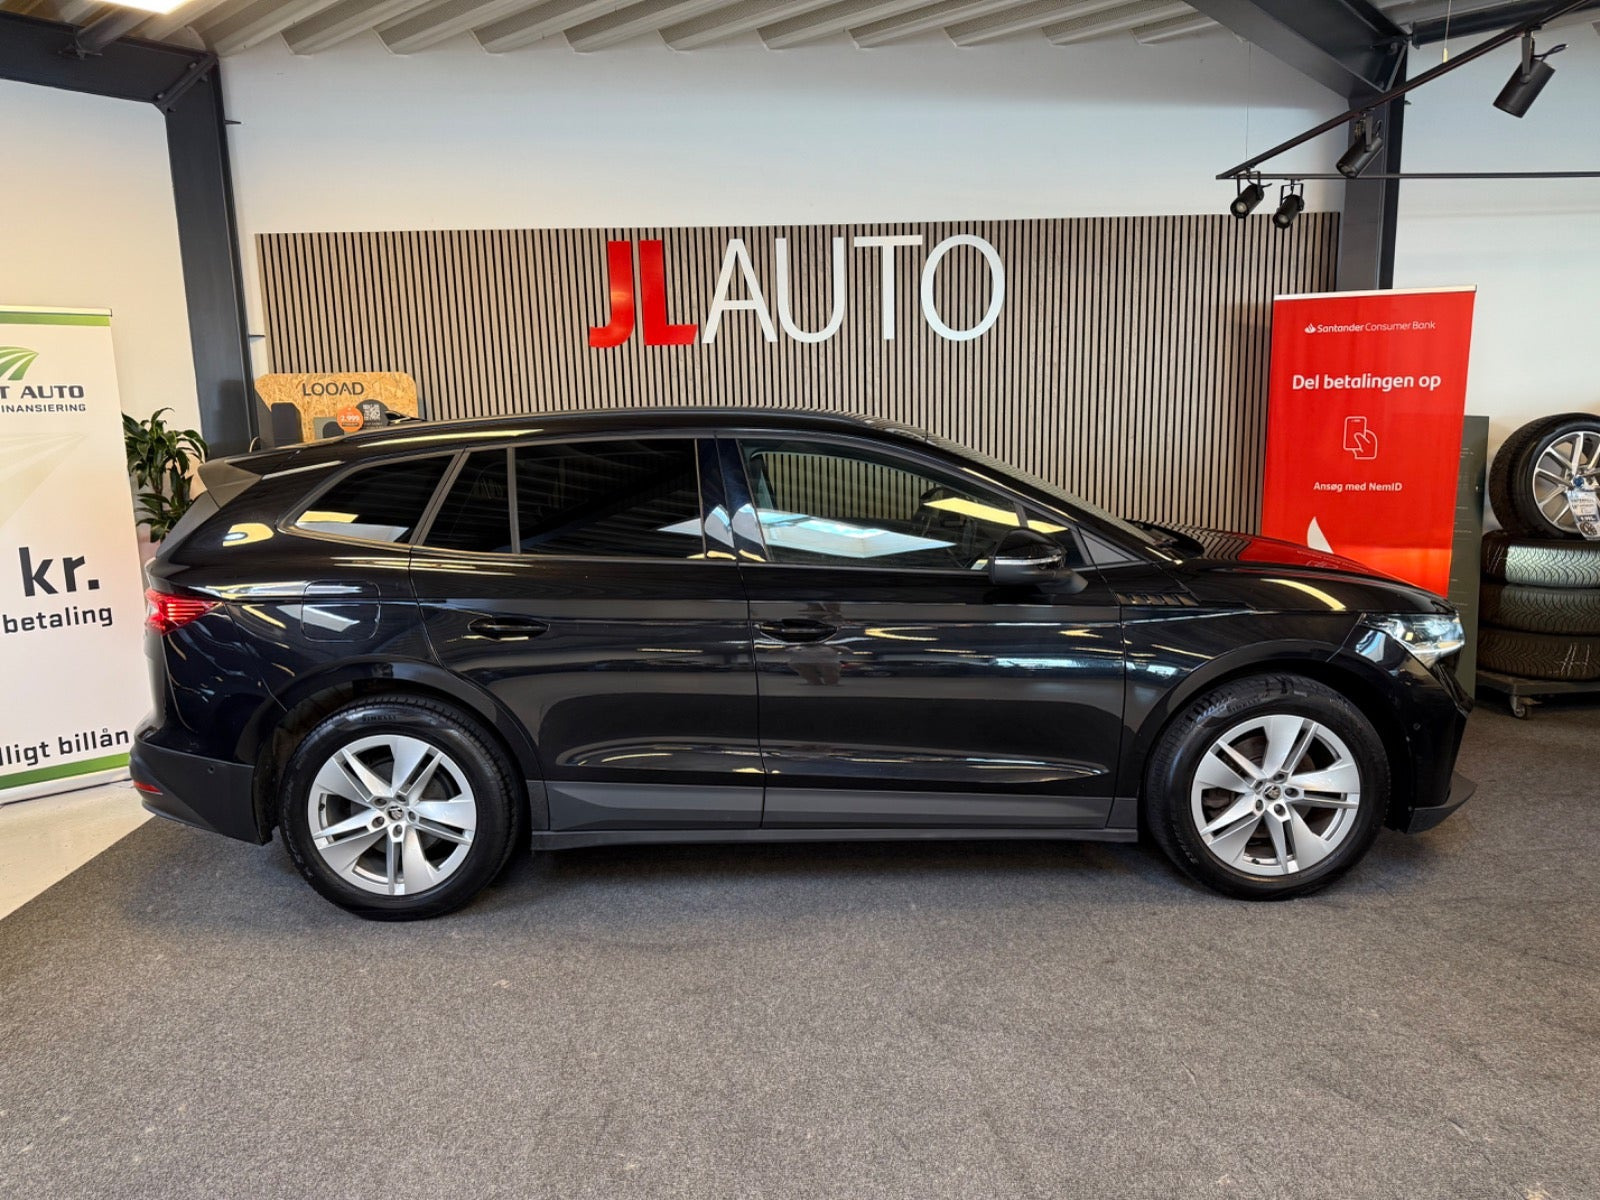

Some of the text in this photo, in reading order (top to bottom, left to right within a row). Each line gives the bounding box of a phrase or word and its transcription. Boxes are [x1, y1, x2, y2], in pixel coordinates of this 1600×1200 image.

[702, 234, 1006, 344] AUTO
[1317, 320, 1435, 333] Santander Consumer Bank
[302, 381, 365, 397] LOOAD
[1292, 373, 1441, 392] Del betalingen op
[20, 385, 84, 399] AUTO
[1, 403, 86, 413] INANSIERING
[1314, 481, 1403, 493] Ansøg med NemID
[18, 546, 100, 597] kr.
[3, 606, 113, 634] betaling
[58, 727, 129, 755] billån
